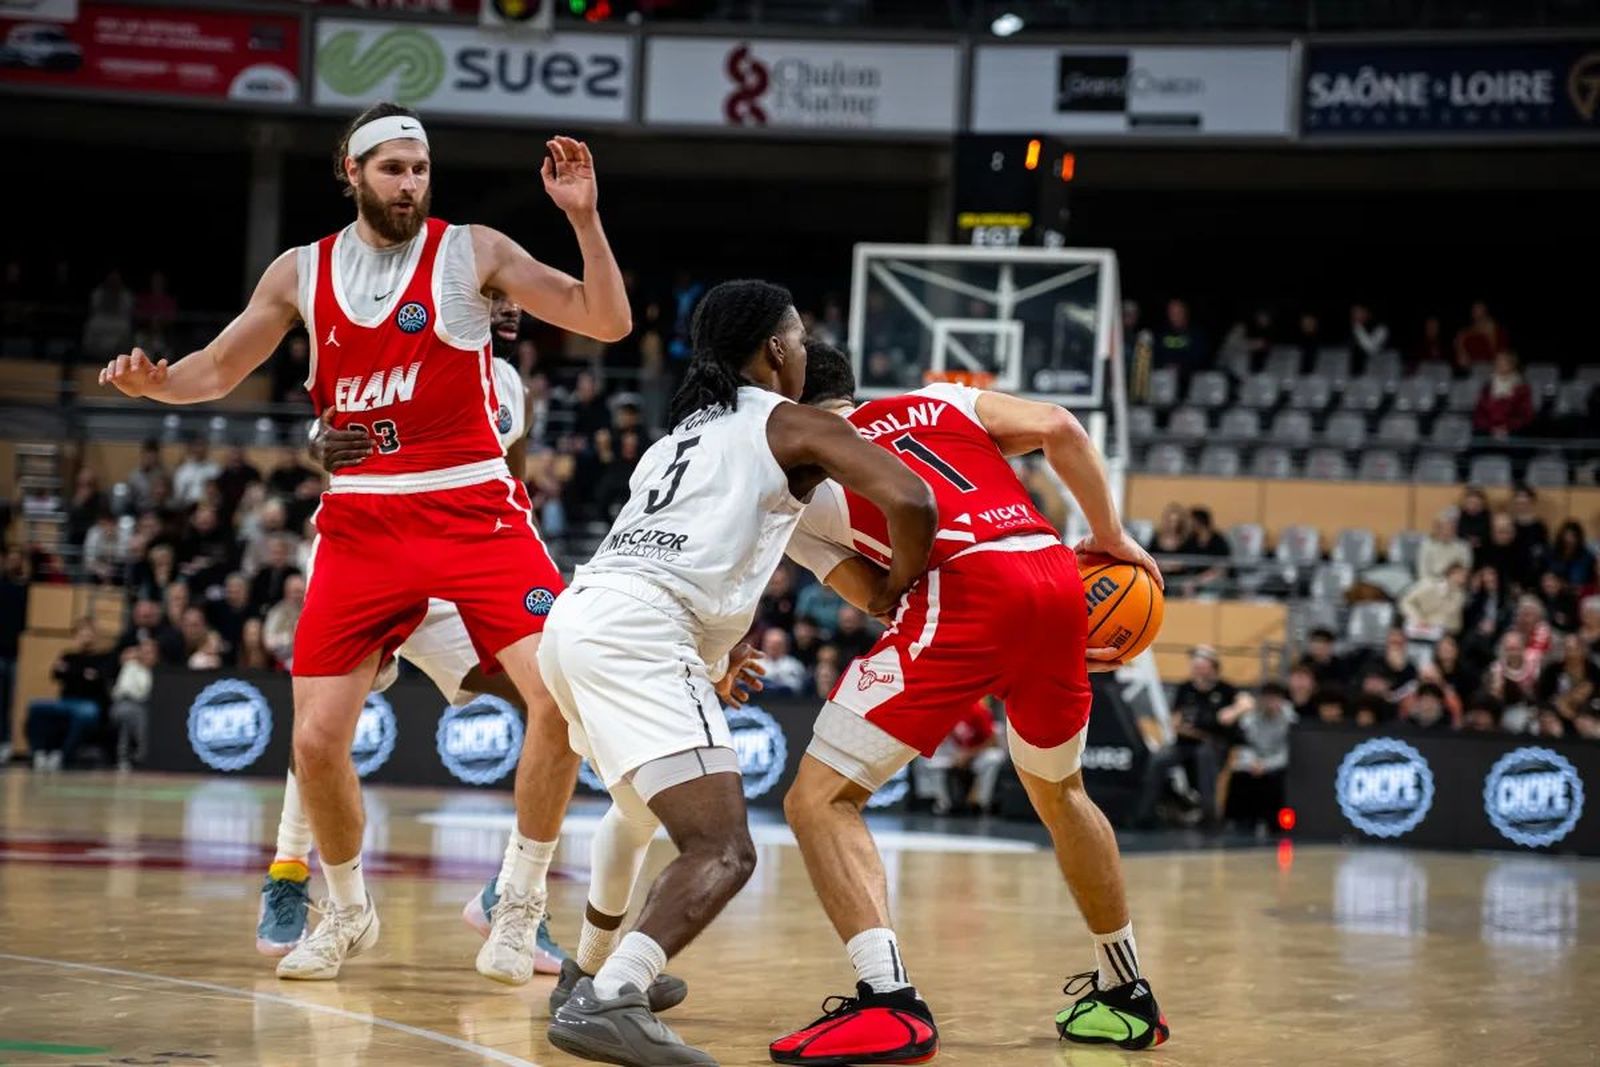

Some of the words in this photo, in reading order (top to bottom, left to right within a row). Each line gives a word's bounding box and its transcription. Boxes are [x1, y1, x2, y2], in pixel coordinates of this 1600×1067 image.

[454, 49, 621, 98] suez
[1308, 65, 1430, 107] SAÔNE
[1451, 70, 1554, 106] LOIRE
[336, 361, 422, 412] ELAN
[644, 435, 702, 515] 5
[891, 431, 978, 494] 1
[977, 504, 1030, 524] VICKY
